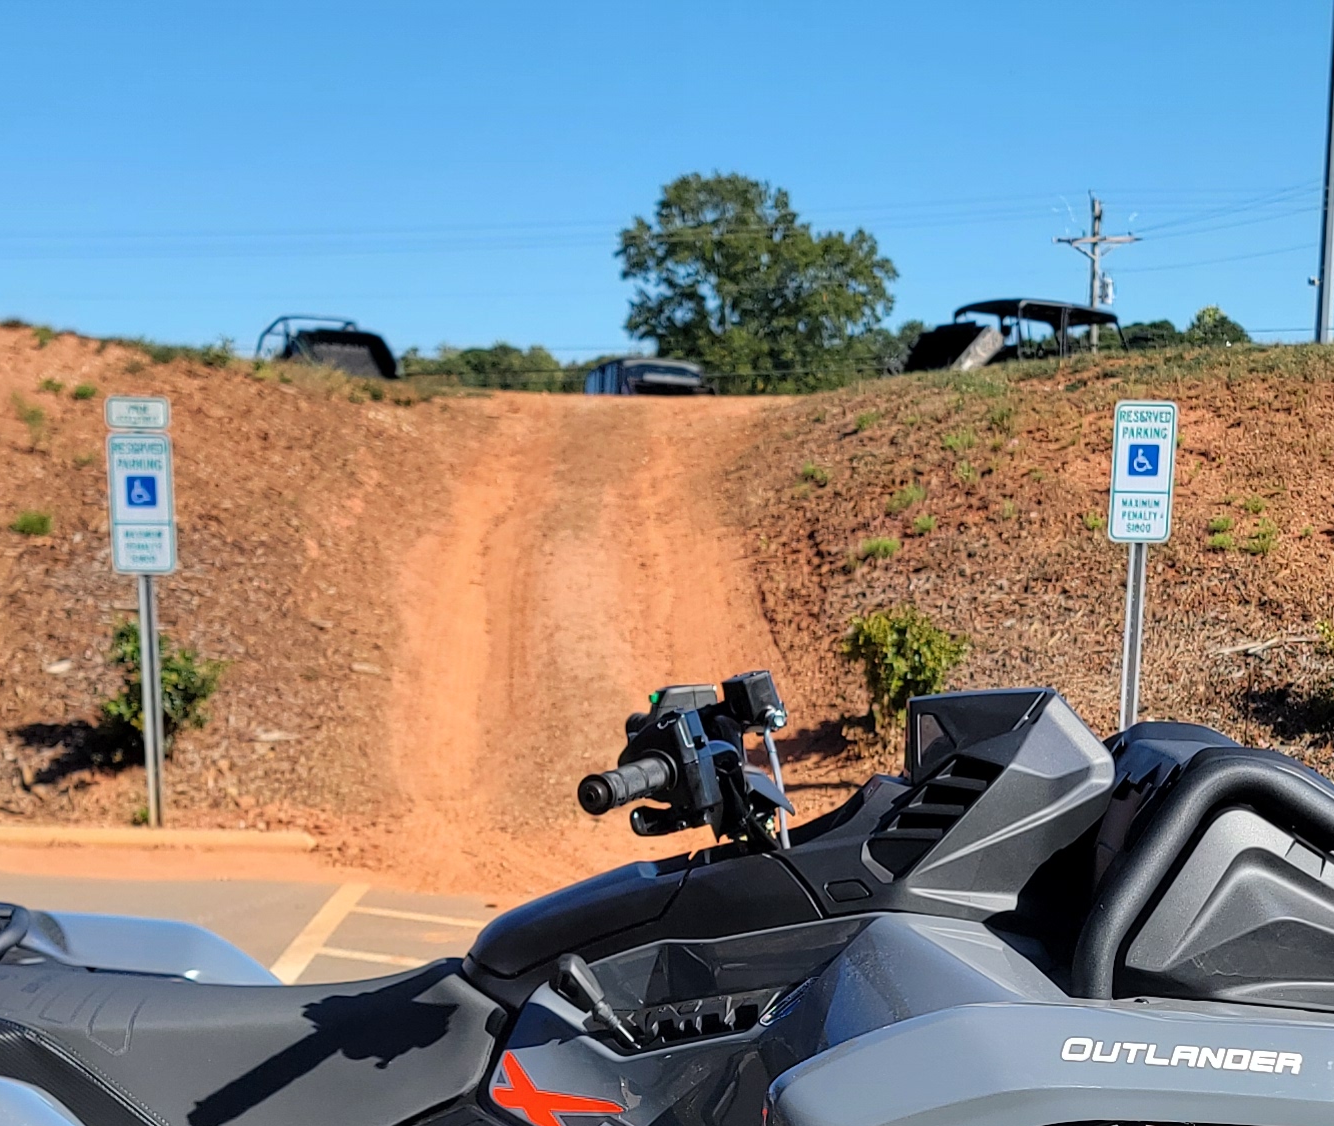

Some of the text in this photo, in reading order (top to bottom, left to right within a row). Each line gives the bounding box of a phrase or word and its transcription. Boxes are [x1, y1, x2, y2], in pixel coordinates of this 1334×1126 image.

[1119, 410, 1171, 423] RESERVED
[1122, 426, 1168, 440] PARKING
[1121, 498, 1160, 508] MAXIMUM
[1121, 510, 1157, 521] PENALTY
